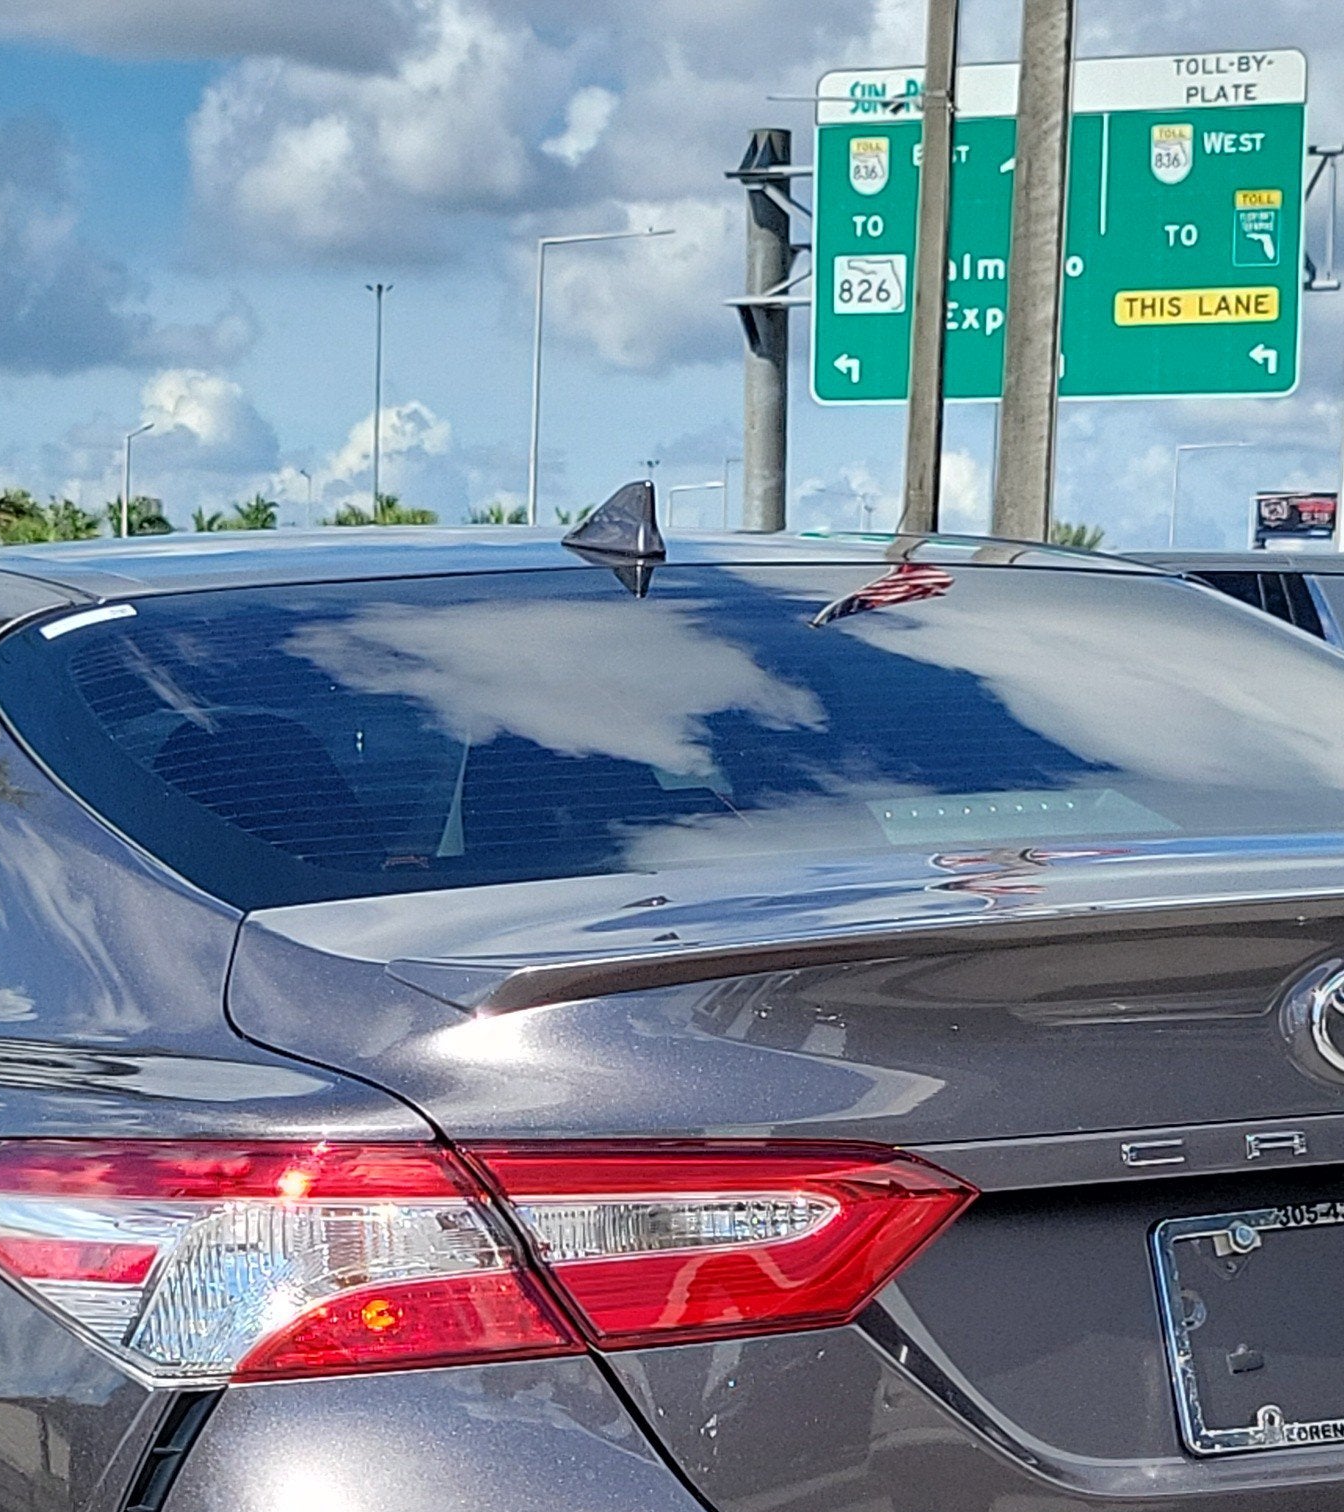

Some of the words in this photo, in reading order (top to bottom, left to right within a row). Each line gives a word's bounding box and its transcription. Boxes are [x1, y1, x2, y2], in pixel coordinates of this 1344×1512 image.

[1173, 55, 1273, 76] TOLL-BY-
[1186, 83, 1257, 103] PLATE
[1204, 132, 1265, 154] WEST
[1156, 152, 1181, 169] 836
[853, 164, 878, 180] 836
[1242, 193, 1275, 205] TOLL
[852, 215, 884, 237] TO
[1165, 224, 1198, 247] TO
[839, 279, 891, 303] 826
[1124, 297, 1182, 318] THIS
[1199, 293, 1270, 316] LANE
